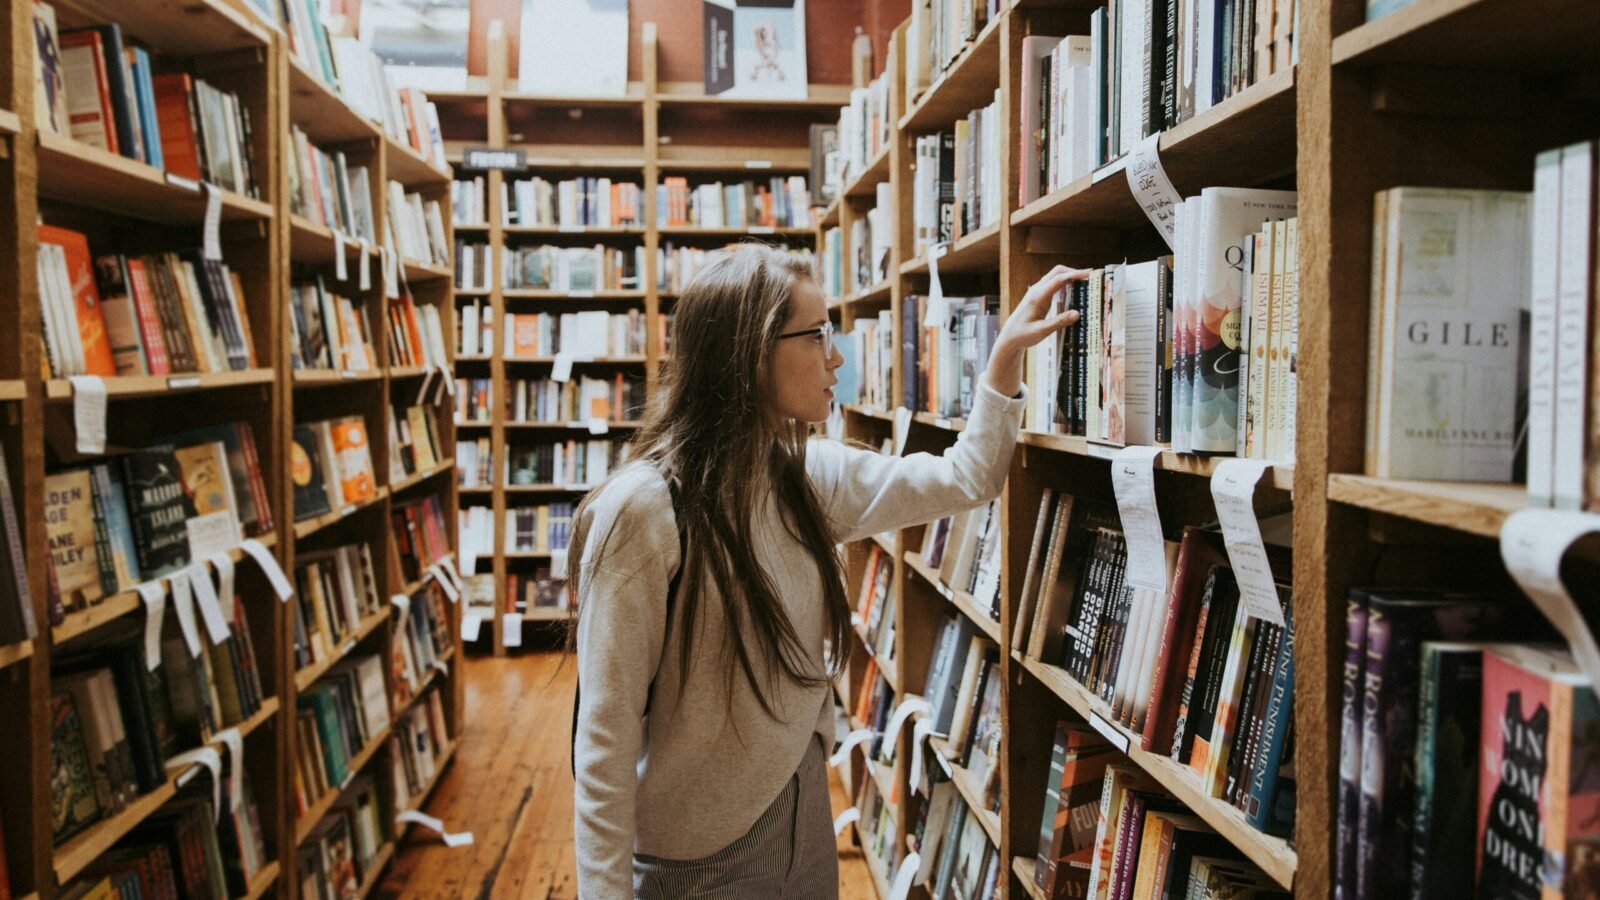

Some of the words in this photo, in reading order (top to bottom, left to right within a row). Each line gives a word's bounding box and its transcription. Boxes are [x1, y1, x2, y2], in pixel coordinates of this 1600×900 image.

[1165, 43, 1174, 92] BLEEDING
[1164, 94, 1173, 120] EDGE
[1256, 272, 1269, 334] ISHMAEL
[1271, 273, 1281, 335] ISHMAEL
[1282, 272, 1293, 333] ISHMAEL
[1408, 321, 1510, 348] GILE
[1405, 428, 1487, 439] MARILYNNE
[48, 532, 75, 550] ANE
[1079, 593, 1097, 655] OTARED
[1085, 596, 1103, 659] OTARED
[1253, 684, 1285, 792] PUNISHMENT
